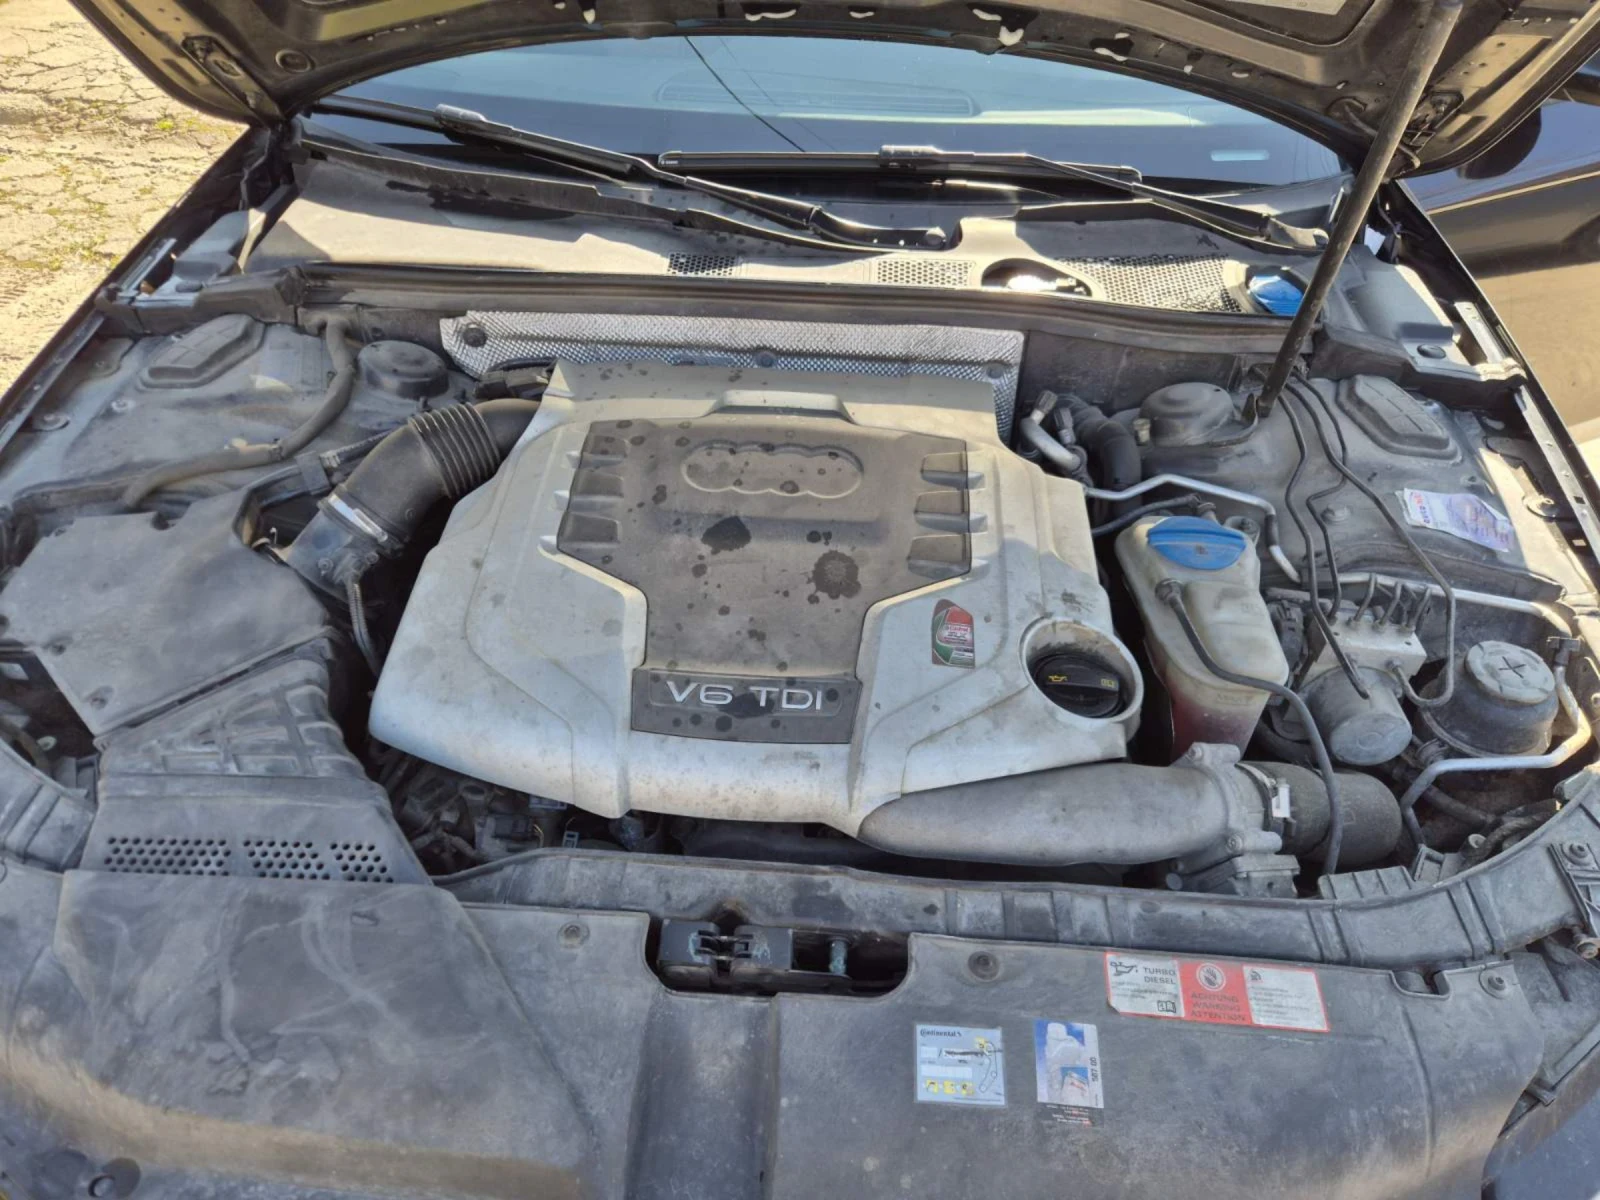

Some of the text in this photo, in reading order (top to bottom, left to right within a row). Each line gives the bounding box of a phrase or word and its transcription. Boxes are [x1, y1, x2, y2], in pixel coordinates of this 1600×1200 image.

[666, 681, 822, 711] V6 TDI
[1143, 967, 1176, 976] TURBO
[1144, 976, 1176, 985] DIESEL
[1191, 992, 1239, 1003] ACHTUNG
[1192, 1001, 1241, 1012] WARNING
[1191, 1010, 1245, 1021] ATTENTION
[920, 1029, 956, 1037] Continental
